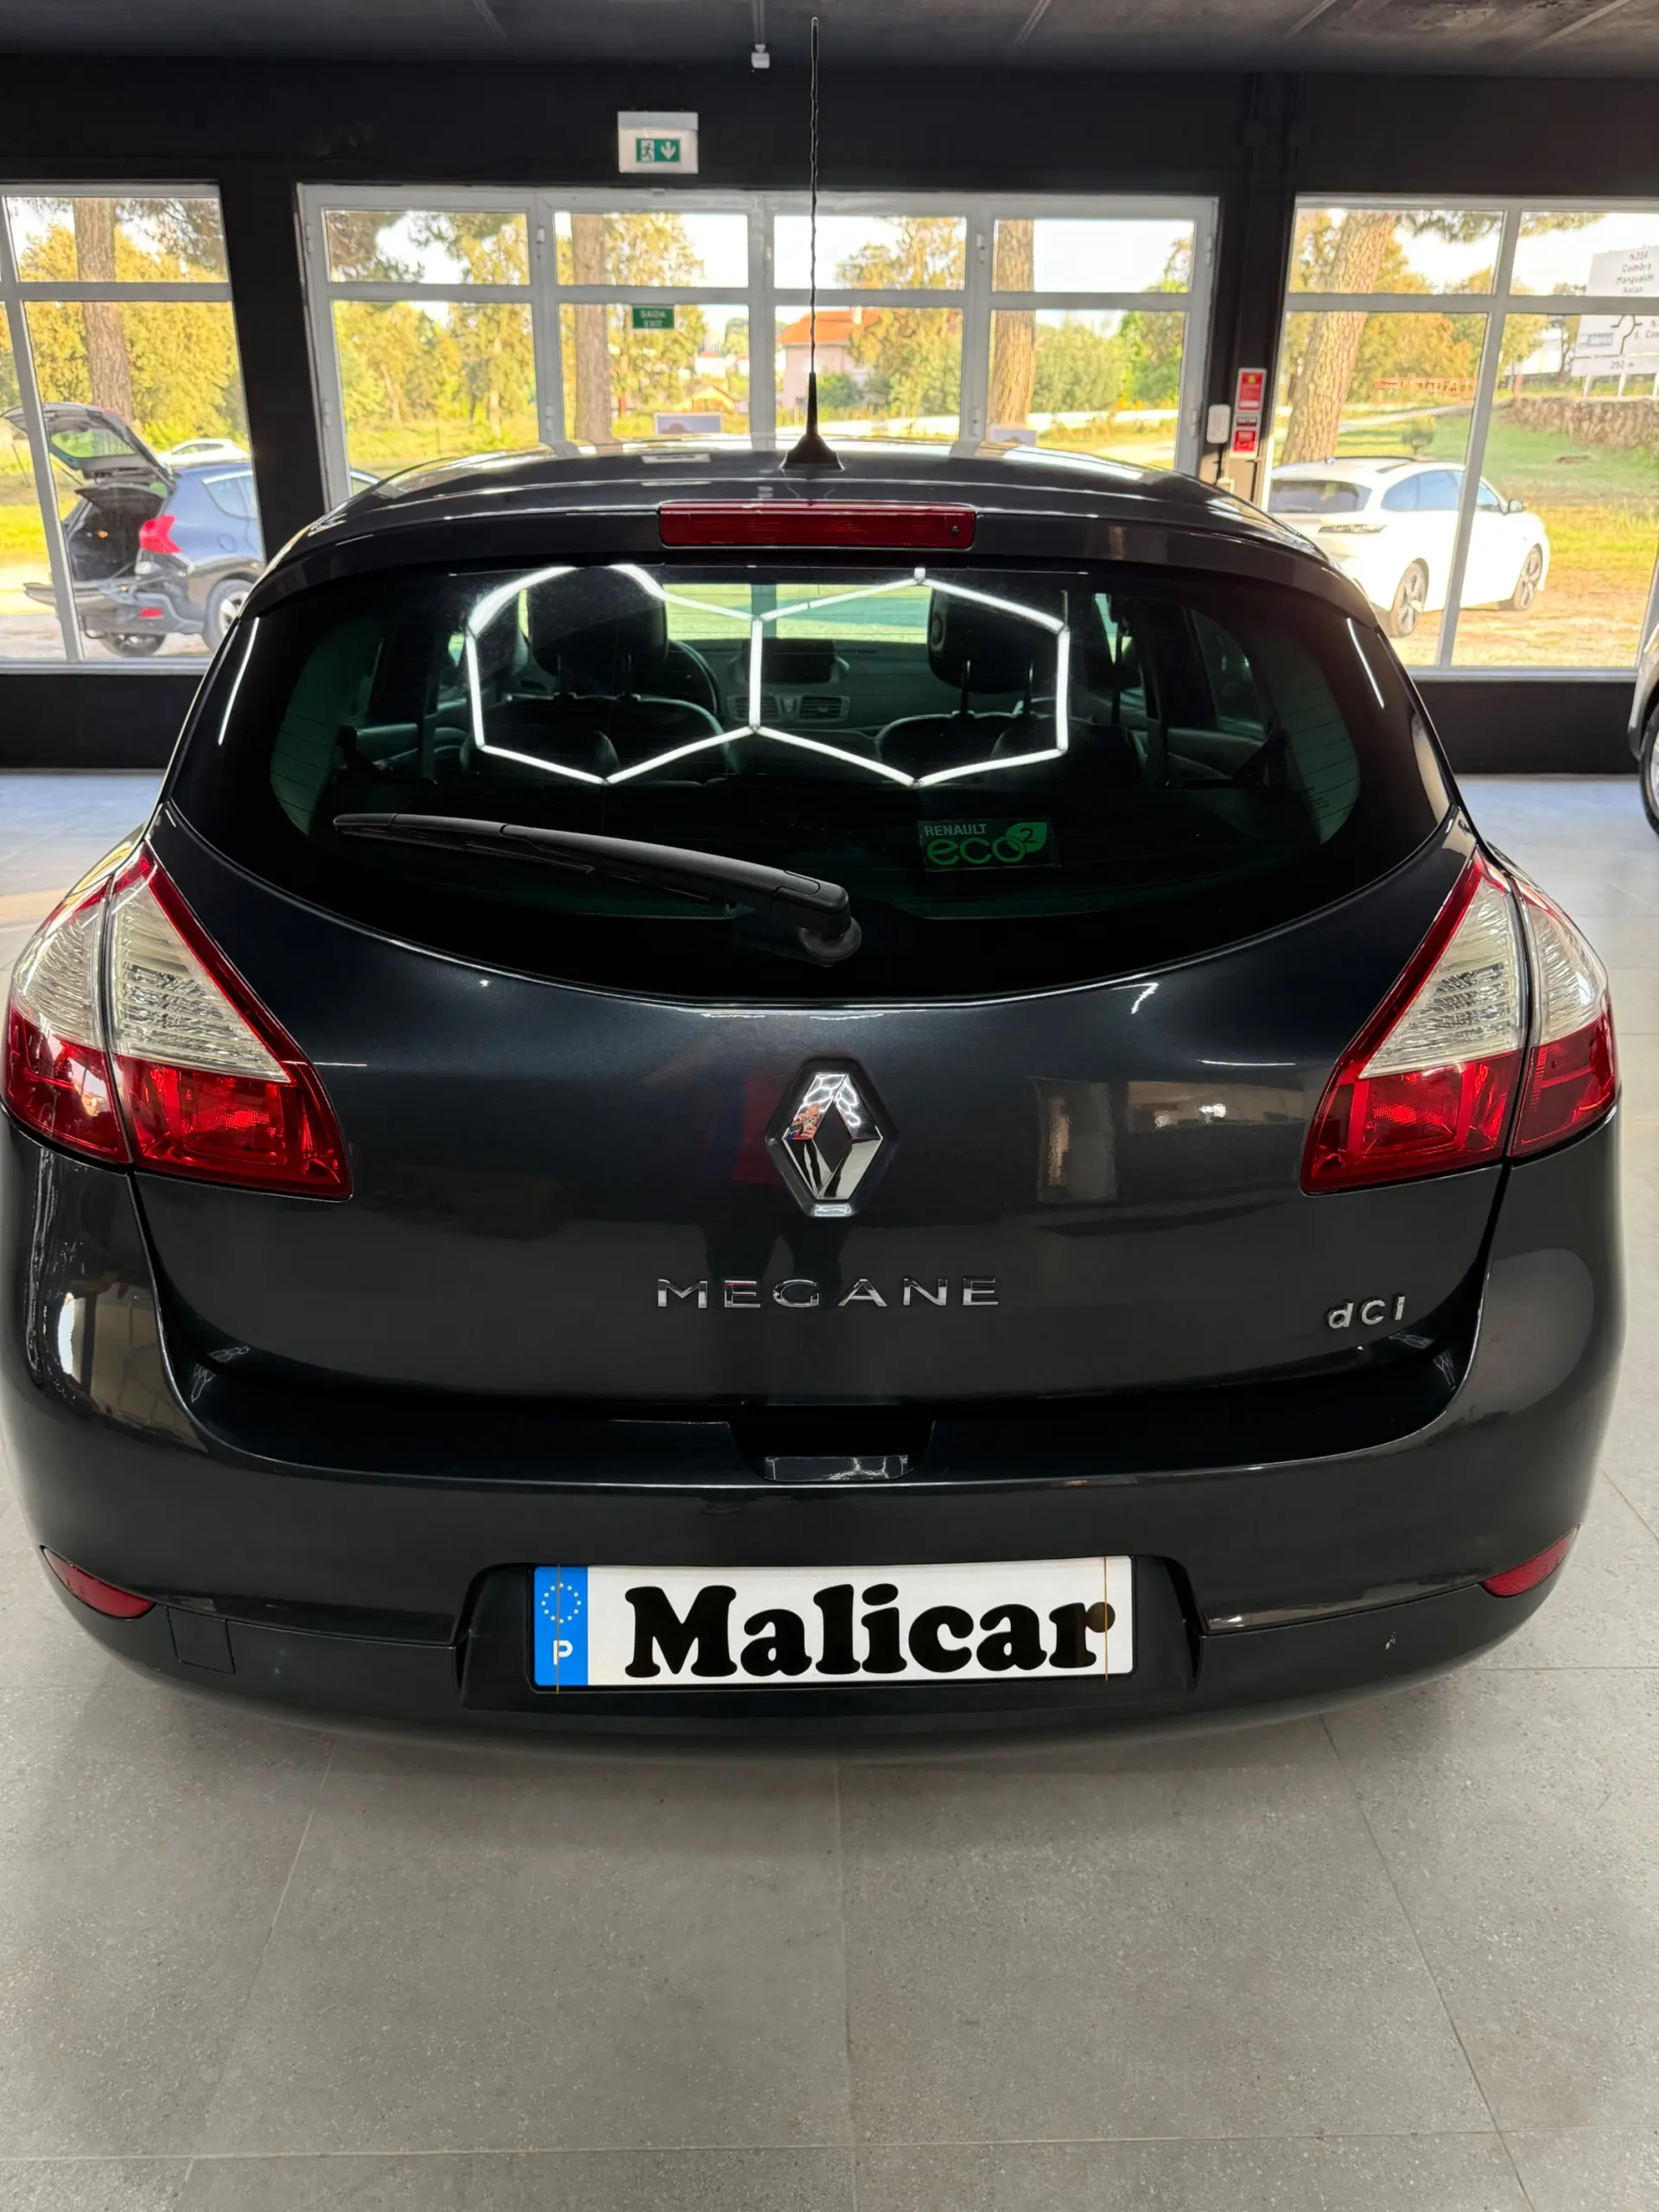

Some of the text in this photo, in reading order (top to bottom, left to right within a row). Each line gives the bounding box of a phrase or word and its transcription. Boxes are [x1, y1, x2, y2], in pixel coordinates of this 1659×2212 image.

[924, 823, 988, 836] RENAULT
[658, 1277, 1000, 1309] MEGANE
[625, 1583, 1116, 1678] Malicar
[553, 1640, 574, 1666] P
